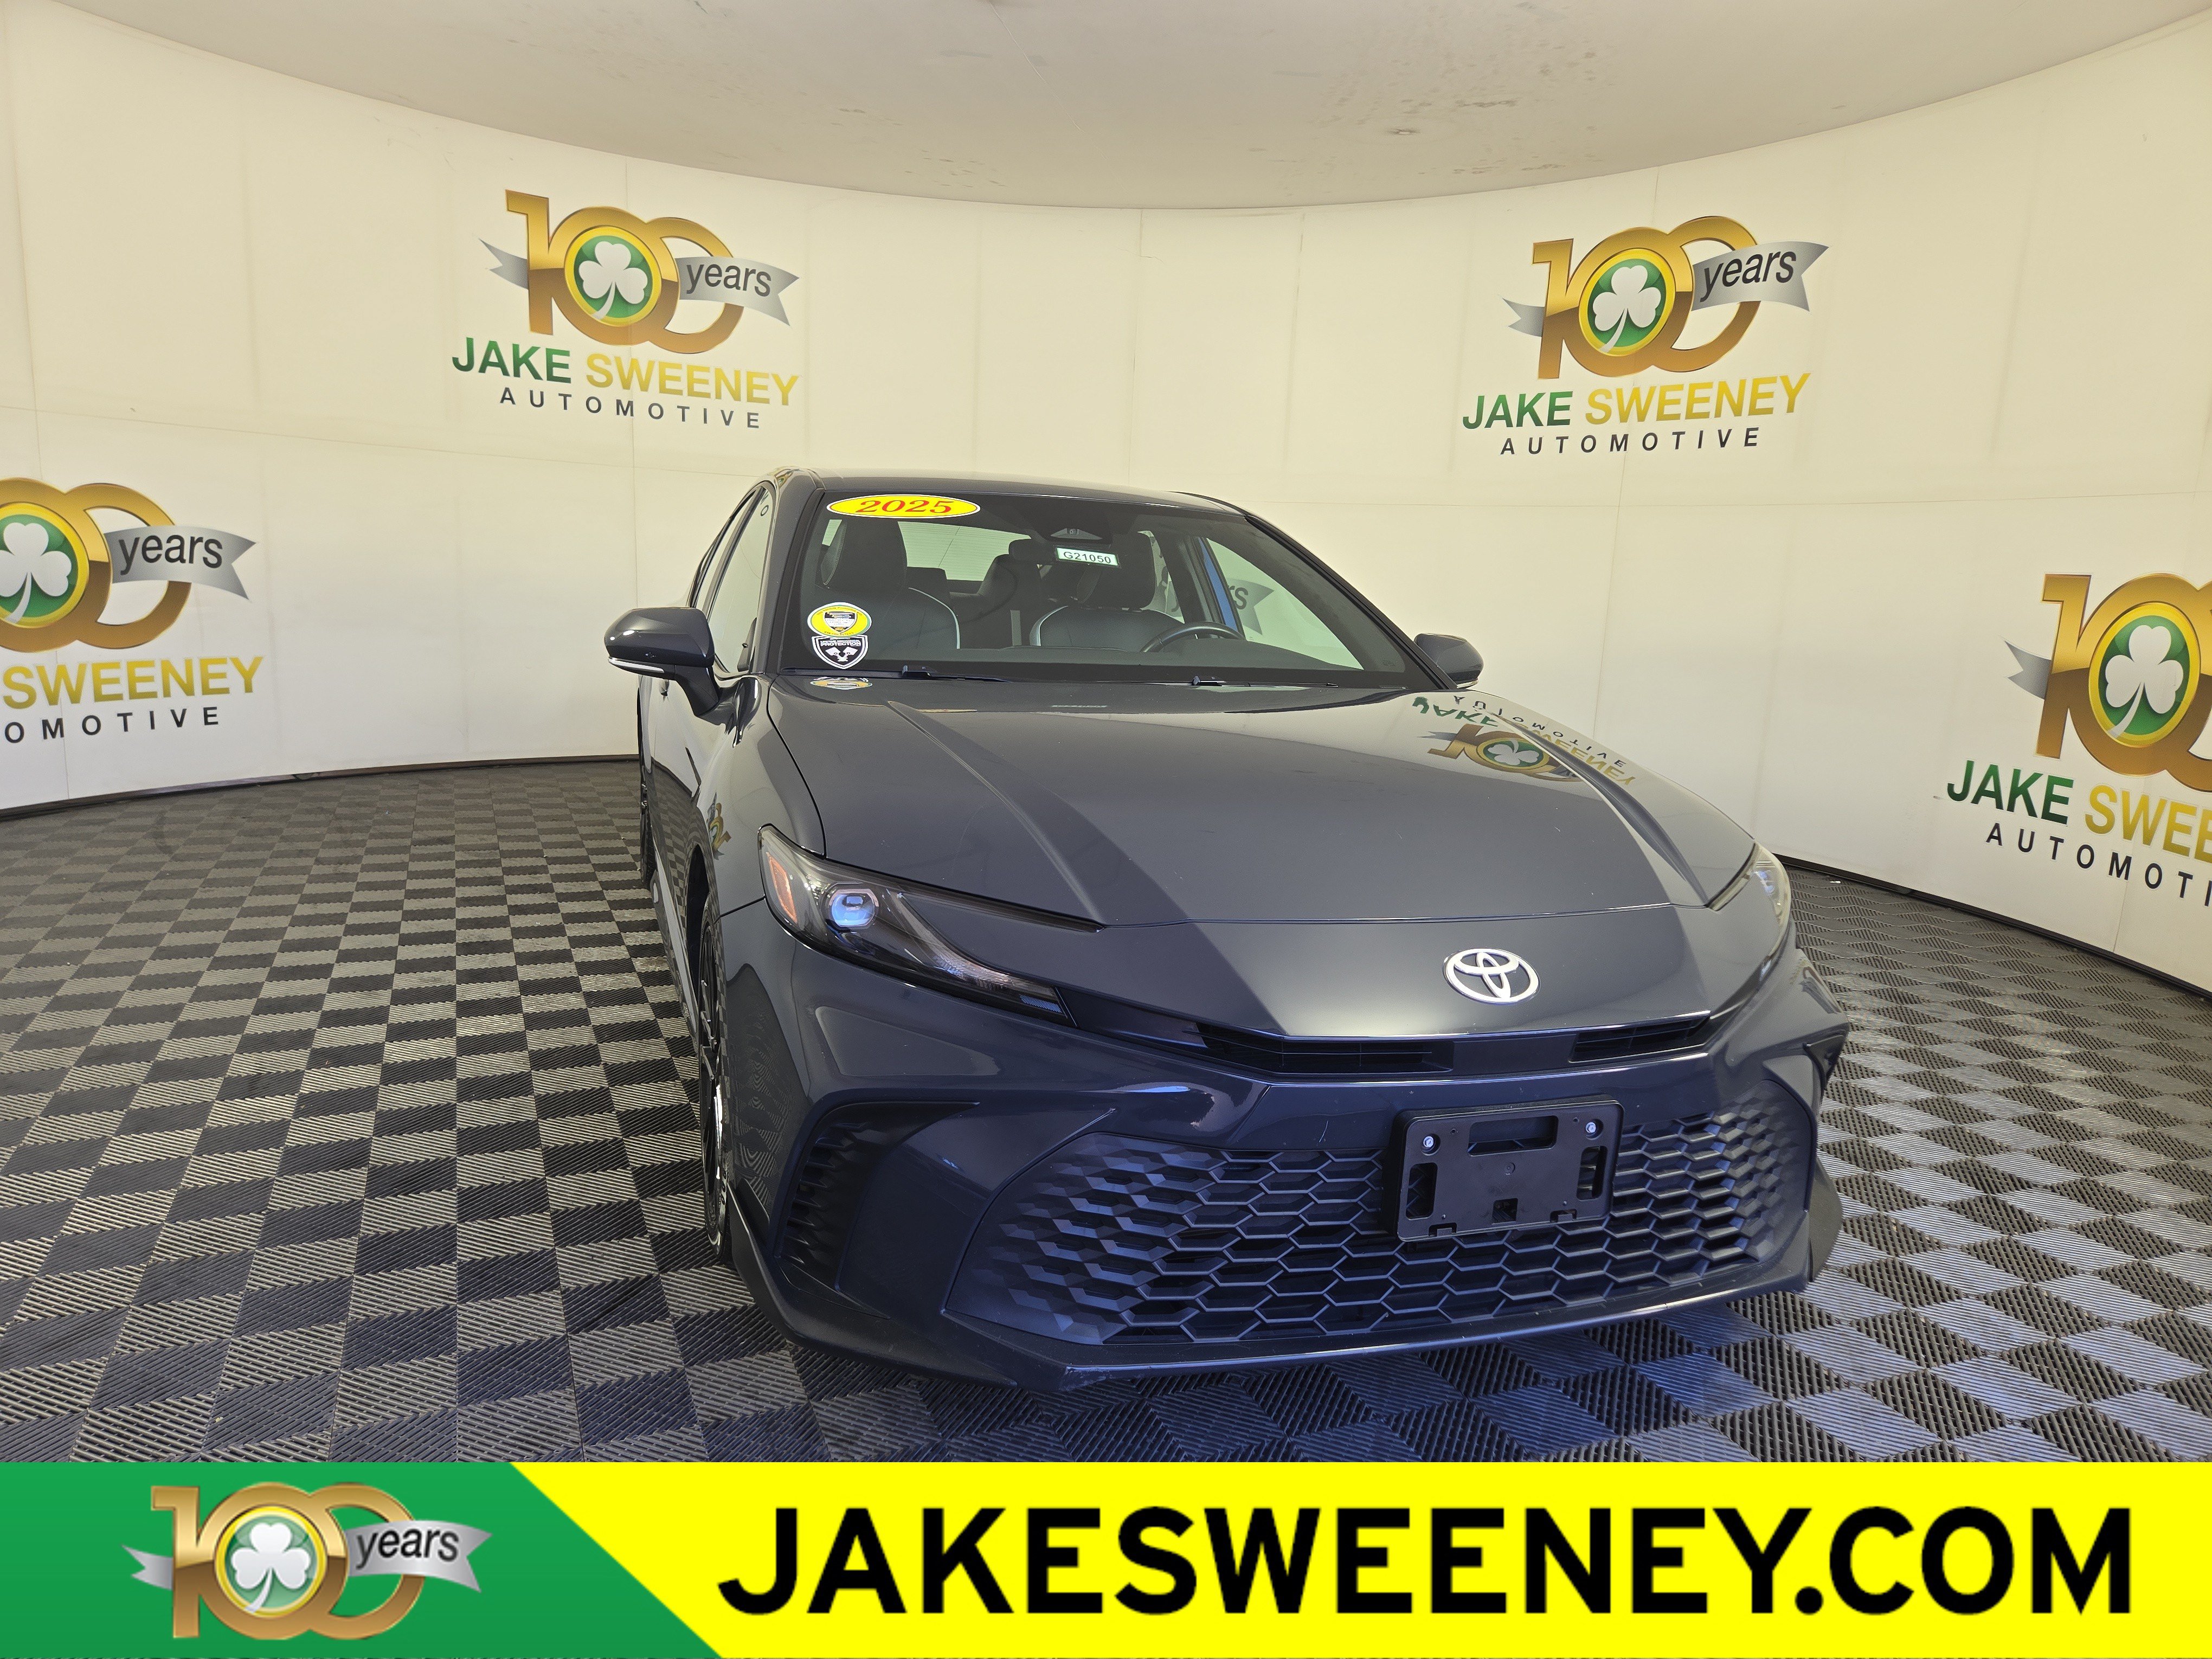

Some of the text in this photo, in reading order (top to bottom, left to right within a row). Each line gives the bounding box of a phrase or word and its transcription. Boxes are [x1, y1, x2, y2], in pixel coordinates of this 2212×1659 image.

[686, 262, 771, 297] years
[1700, 248, 1797, 303] years
[452, 337, 799, 406] JAKE SWEENEY
[499, 387, 760, 429] AUTOMOTIVE
[1463, 373, 1812, 429] JAKE SWEENEY
[1501, 427, 1759, 455] AUTOMOTIVE
[856, 500, 953, 513] 2025
[118, 534, 223, 575] years
[1064, 551, 1111, 564] G21050
[2, 656, 263, 710] SWEENEY
[4, 706, 219, 743] OMOTIVE
[1947, 760, 2212, 864] JAKE SWEE
[1986, 822, 2212, 907] AUTOMOTI
